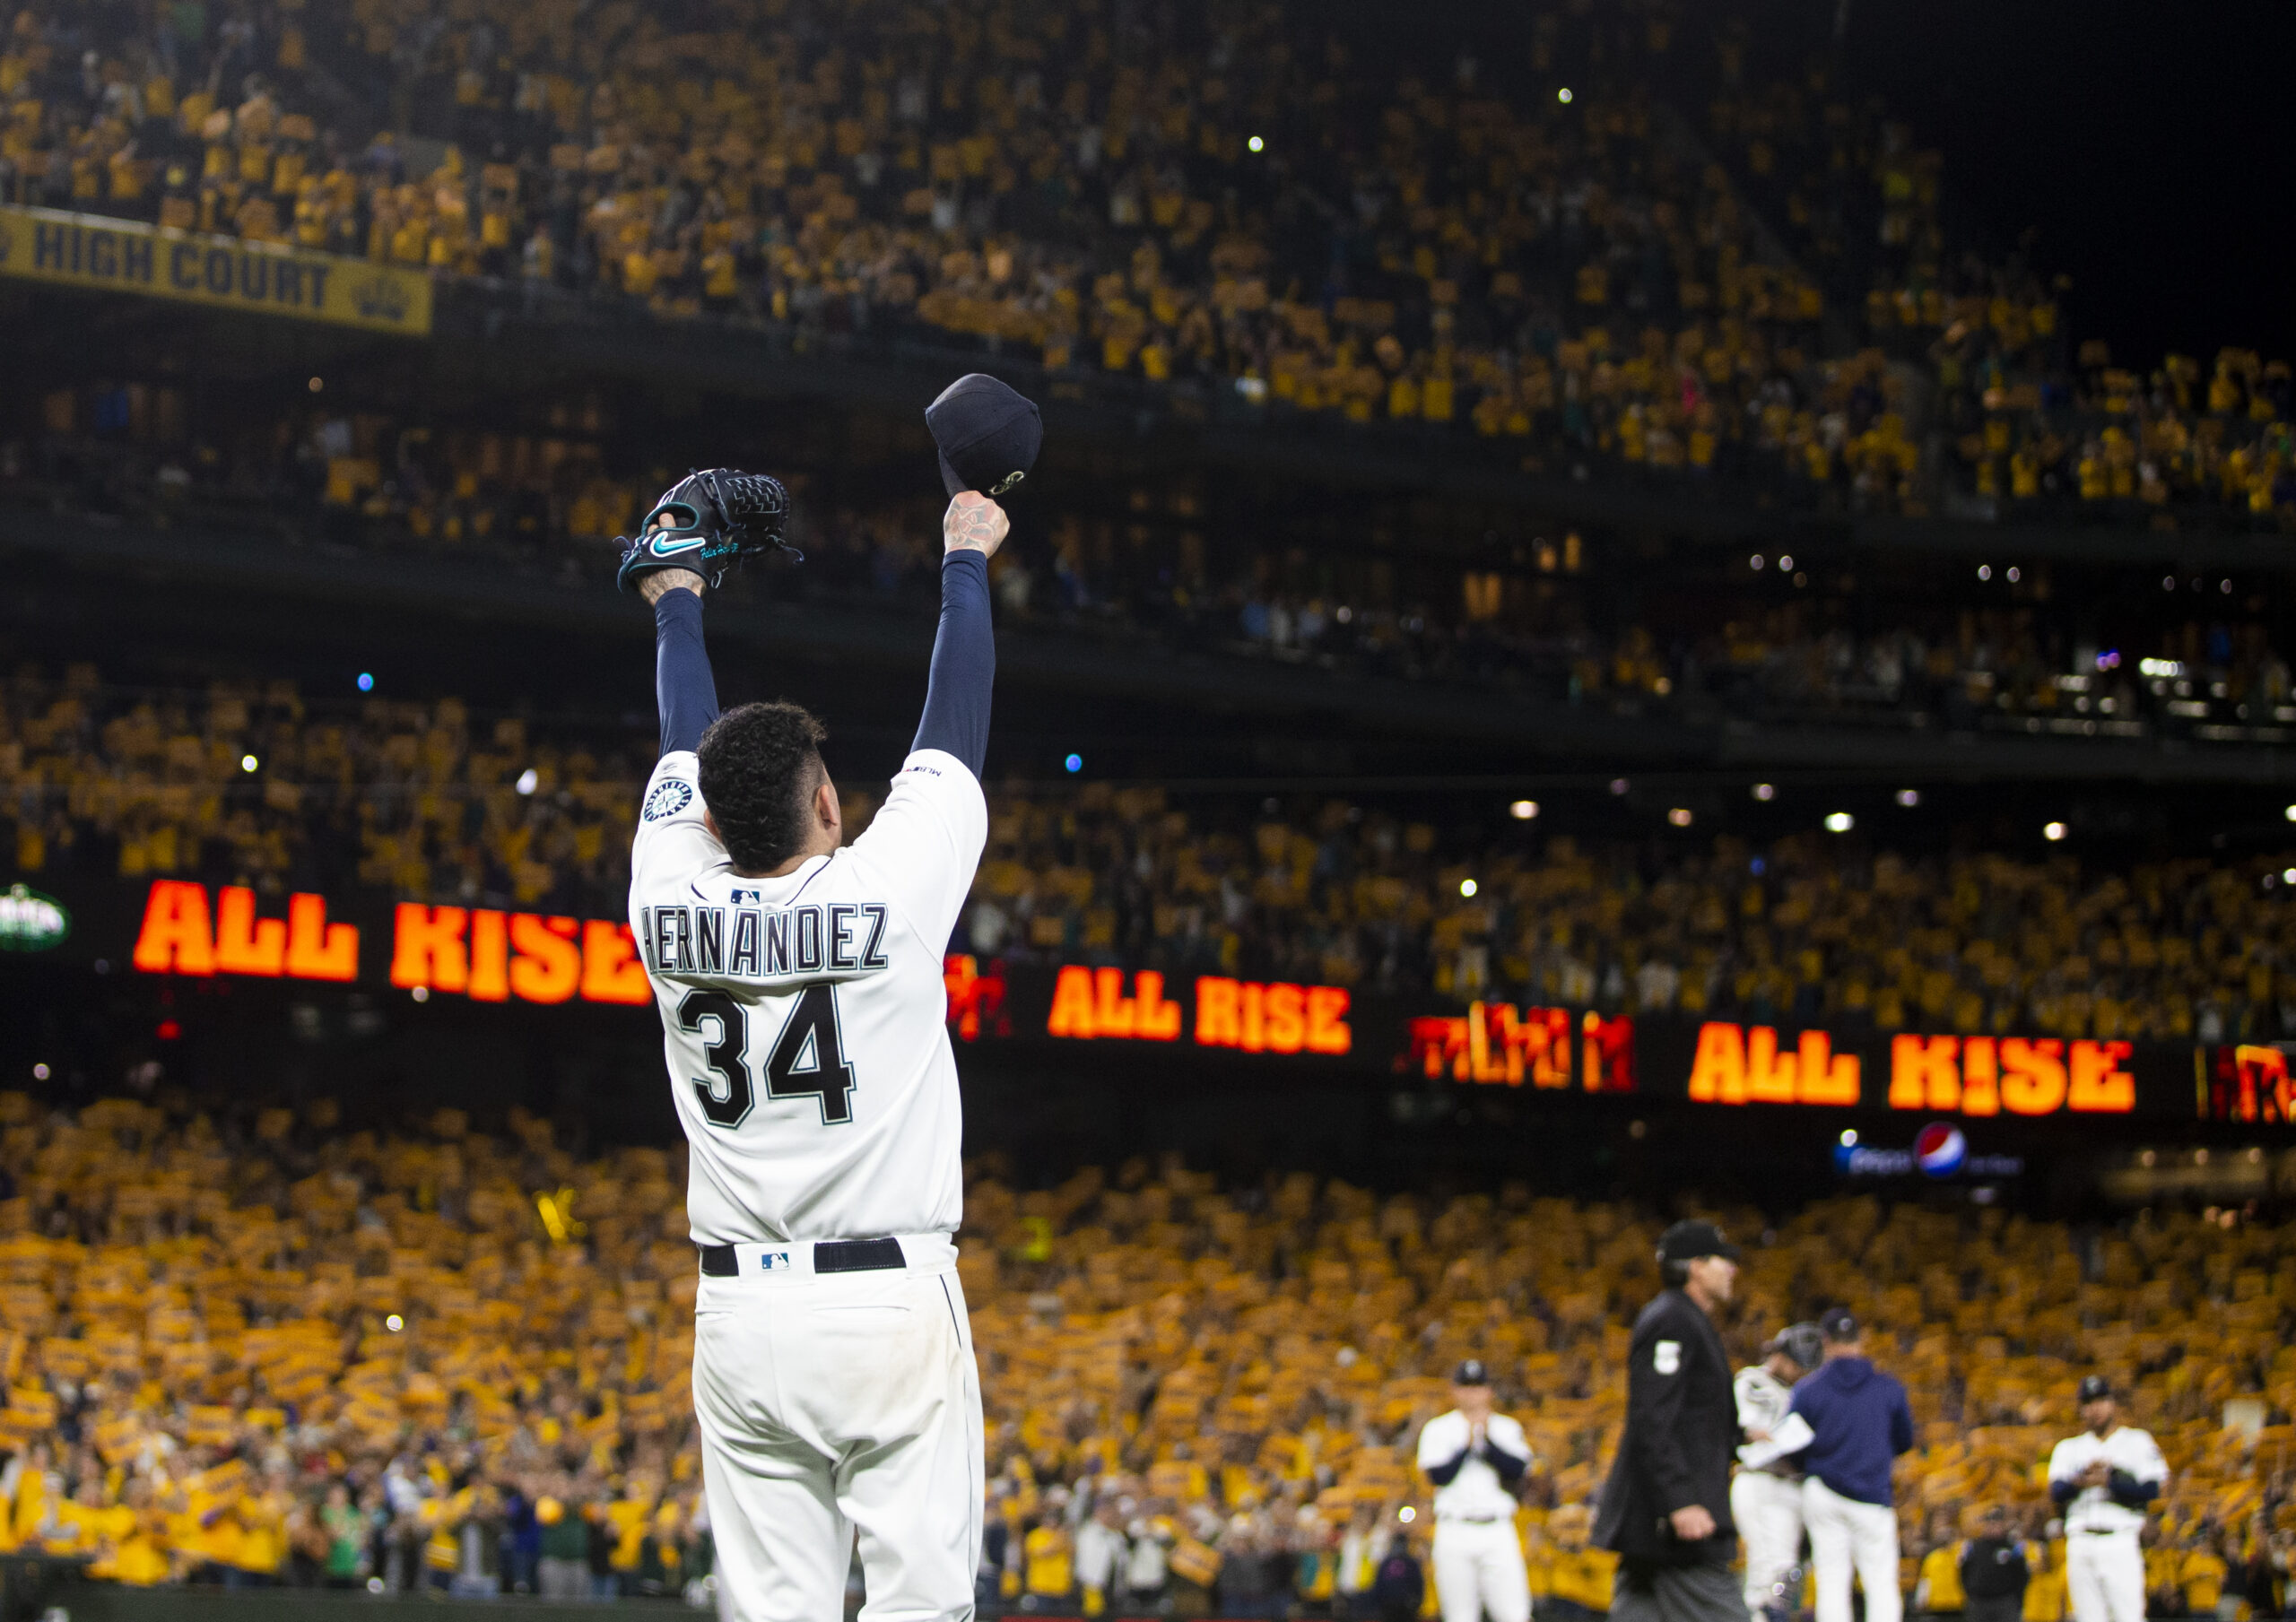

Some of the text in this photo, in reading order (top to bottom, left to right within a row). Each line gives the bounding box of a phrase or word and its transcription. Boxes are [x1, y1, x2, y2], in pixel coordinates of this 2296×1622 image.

[34, 222, 329, 308] HIGH COURT
[134, 880, 358, 982] ALL
[392, 903, 653, 1005] RISE
[641, 903, 889, 976] HERNANDEZ
[676, 980, 857, 1131] 34
[1048, 966, 1181, 1041] ALL
[1195, 976, 1352, 1054] RISE
[1689, 1022, 1861, 1105] ALL
[1888, 1034, 2135, 1116] RISE
